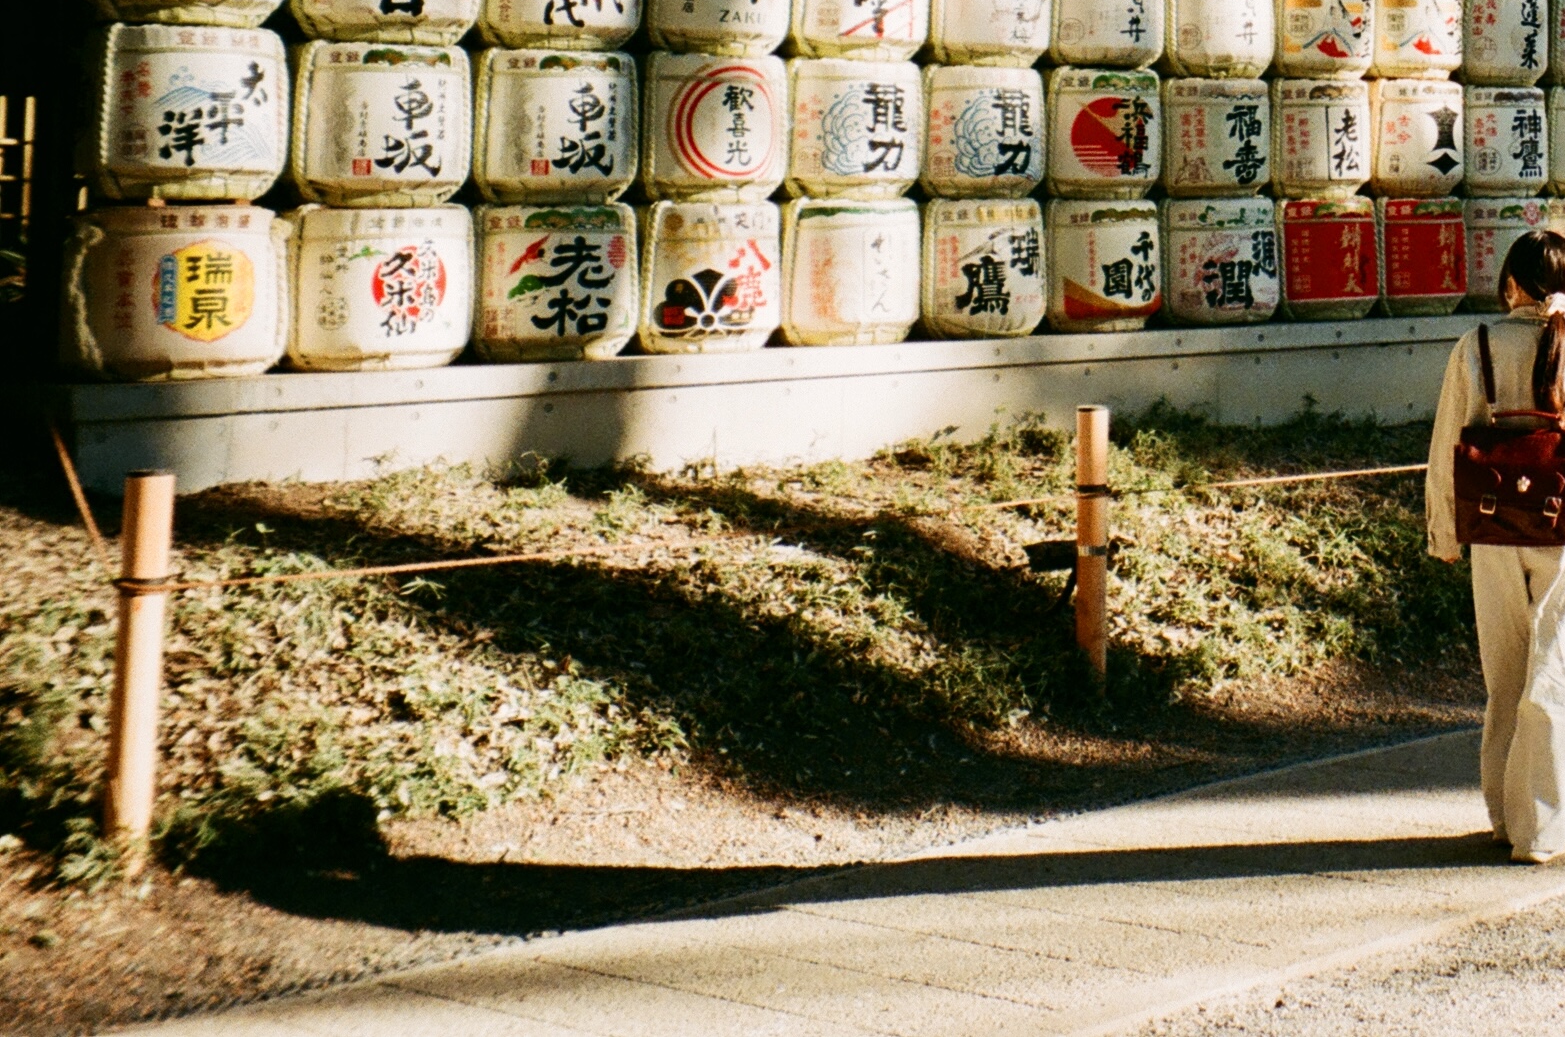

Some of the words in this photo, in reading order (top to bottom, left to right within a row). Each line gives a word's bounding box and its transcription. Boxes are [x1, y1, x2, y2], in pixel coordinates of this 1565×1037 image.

[157, 61, 270, 167] 太平洋
[373, 75, 442, 179] 車坂
[550, 80, 615, 178] 車坂
[862, 81, 908, 174] 龍力
[992, 88, 1034, 175] 龍力
[1331, 107, 1360, 178] 老松
[1511, 108, 1544, 179] 神鷹
[183, 252, 234, 330] 瑞泉
[378, 250, 418, 337] 久米仙
[530, 235, 616, 338] 老松
[720, 238, 772, 310] 八鹿
